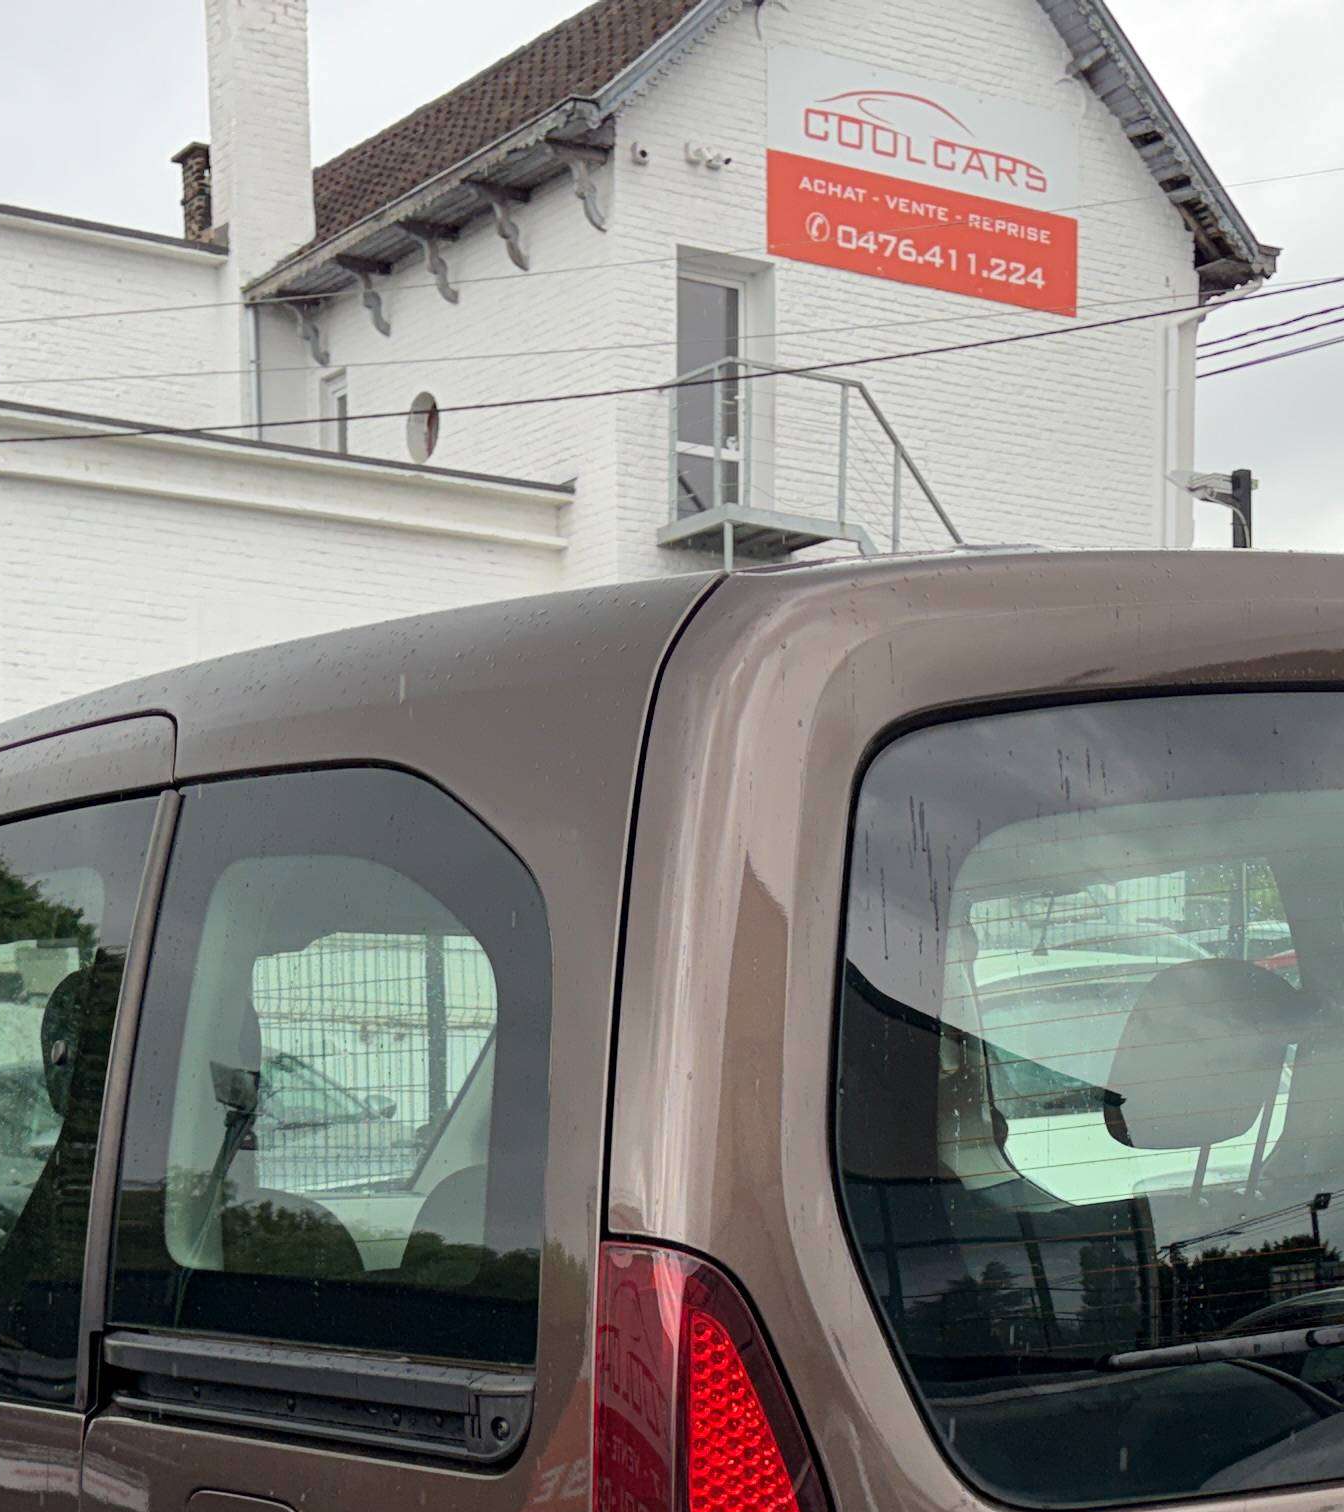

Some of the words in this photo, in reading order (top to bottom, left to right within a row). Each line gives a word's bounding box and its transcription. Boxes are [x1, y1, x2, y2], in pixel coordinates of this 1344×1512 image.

[799, 176, 867, 203] ACHAT
[884, 195, 949, 222] VENTE
[968, 213, 1051, 245] REPRISE
[837, 226, 1046, 289] 0476.411.224
